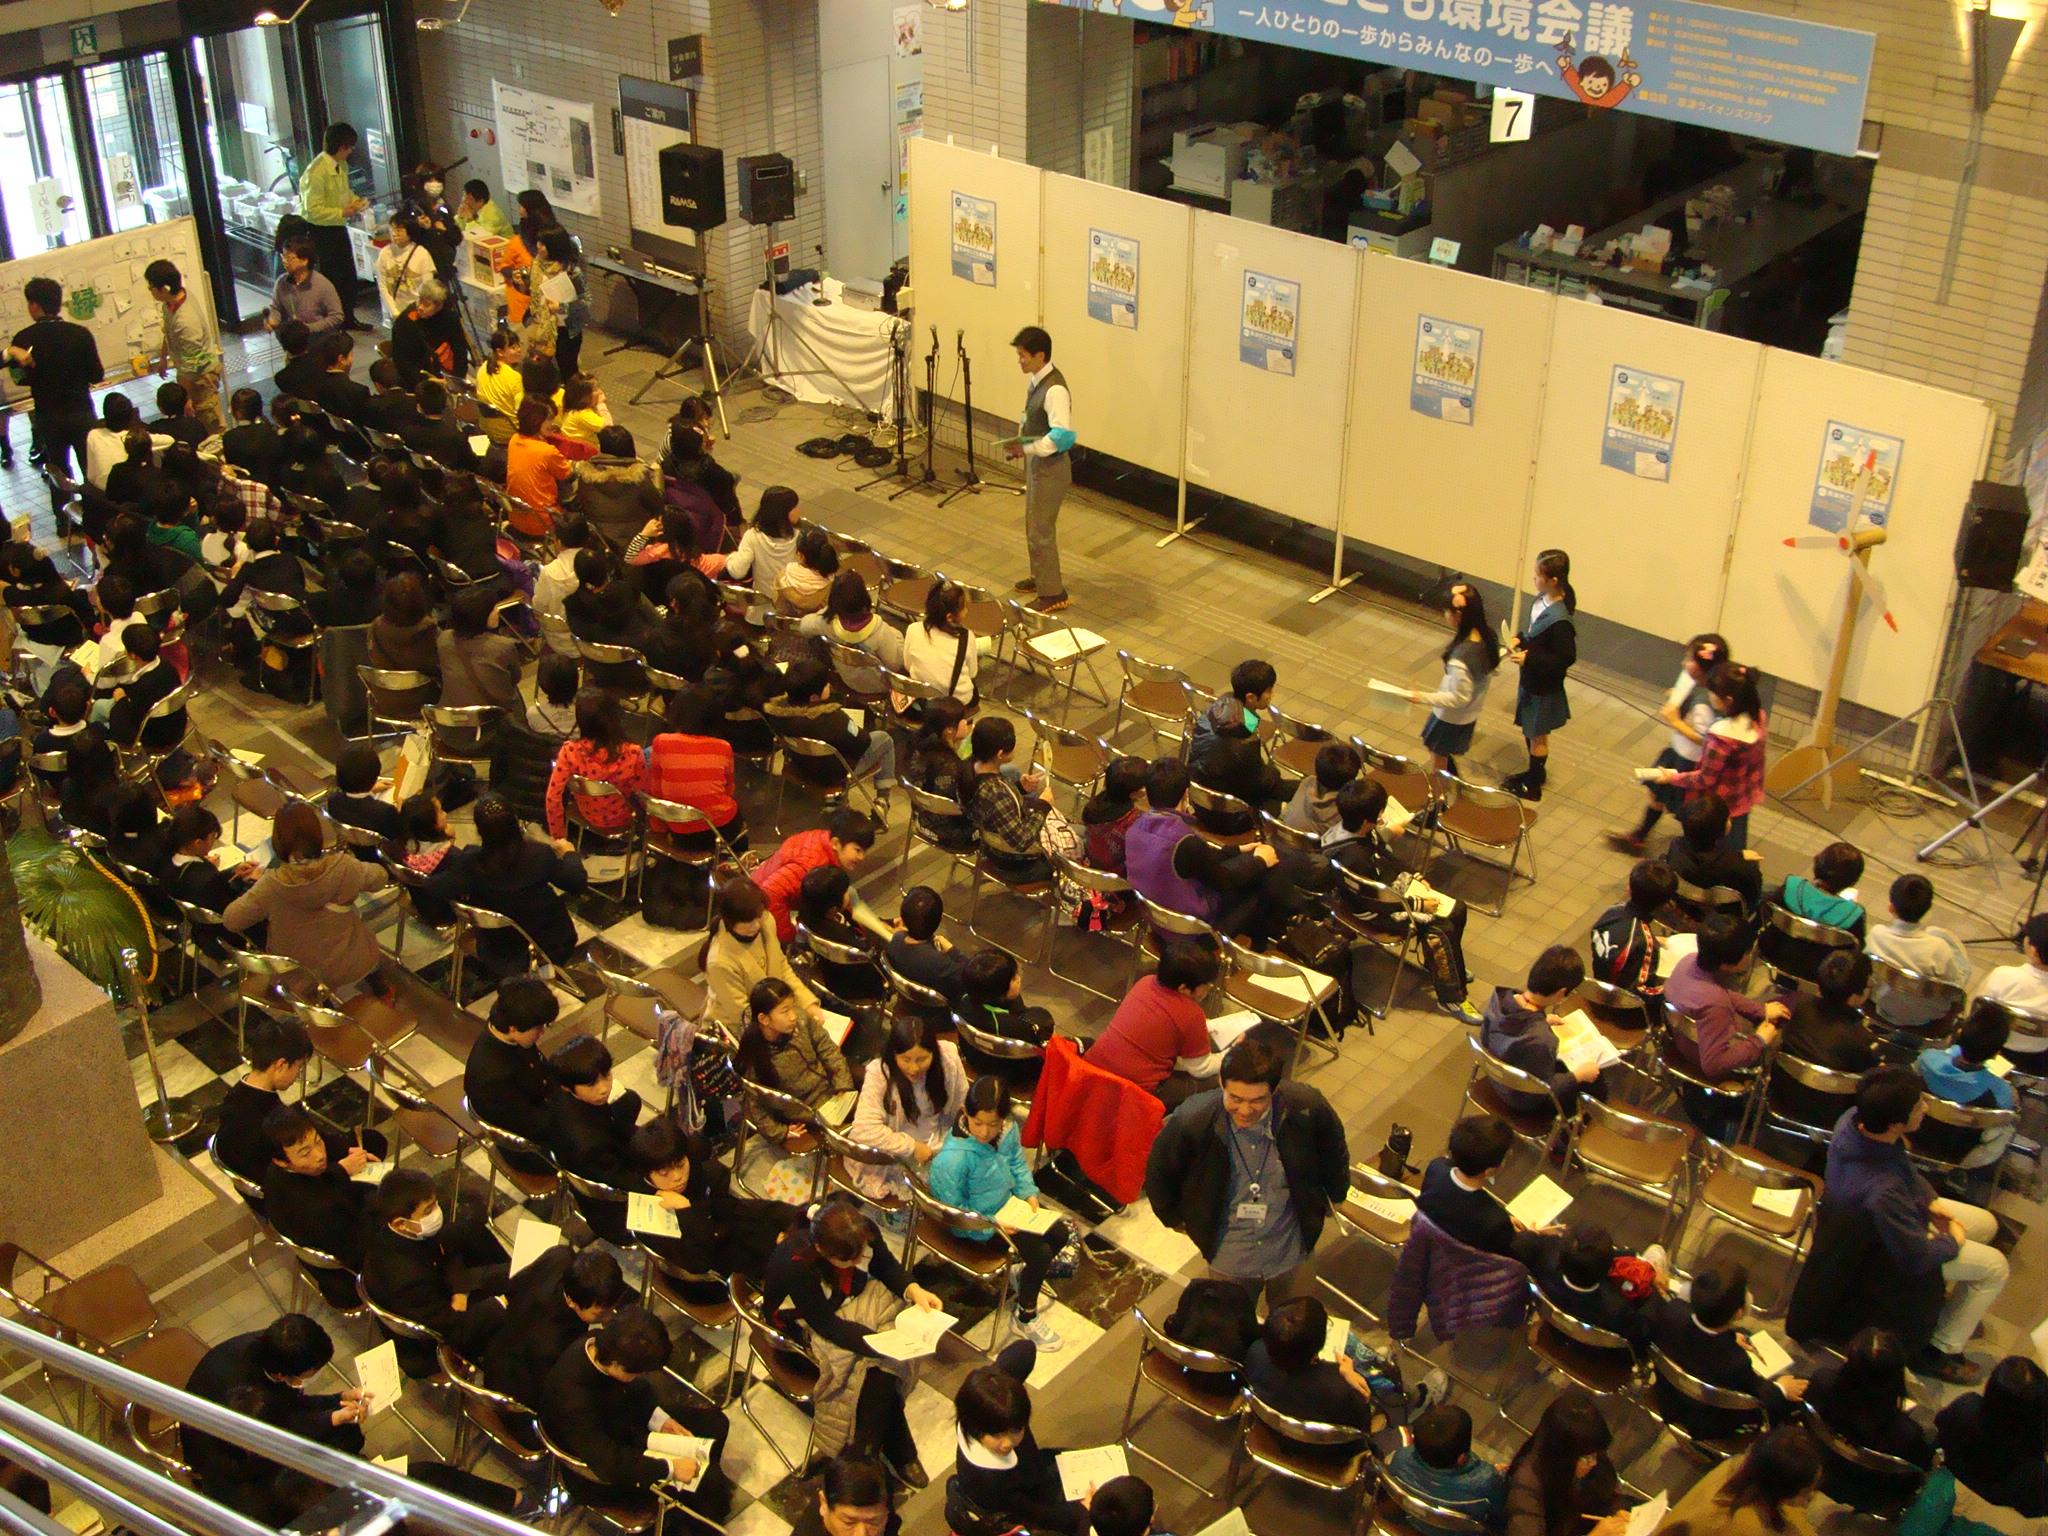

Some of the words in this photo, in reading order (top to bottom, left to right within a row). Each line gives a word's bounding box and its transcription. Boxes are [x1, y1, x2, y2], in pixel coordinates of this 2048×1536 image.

[1238, 7, 1554, 76] 一人ひとりの一歩からみんなの一歩へ
[1312, 0, 1635, 59] 環境会議
[1504, 101, 1524, 138] 7
[669, 195, 699, 210] RAMSA
